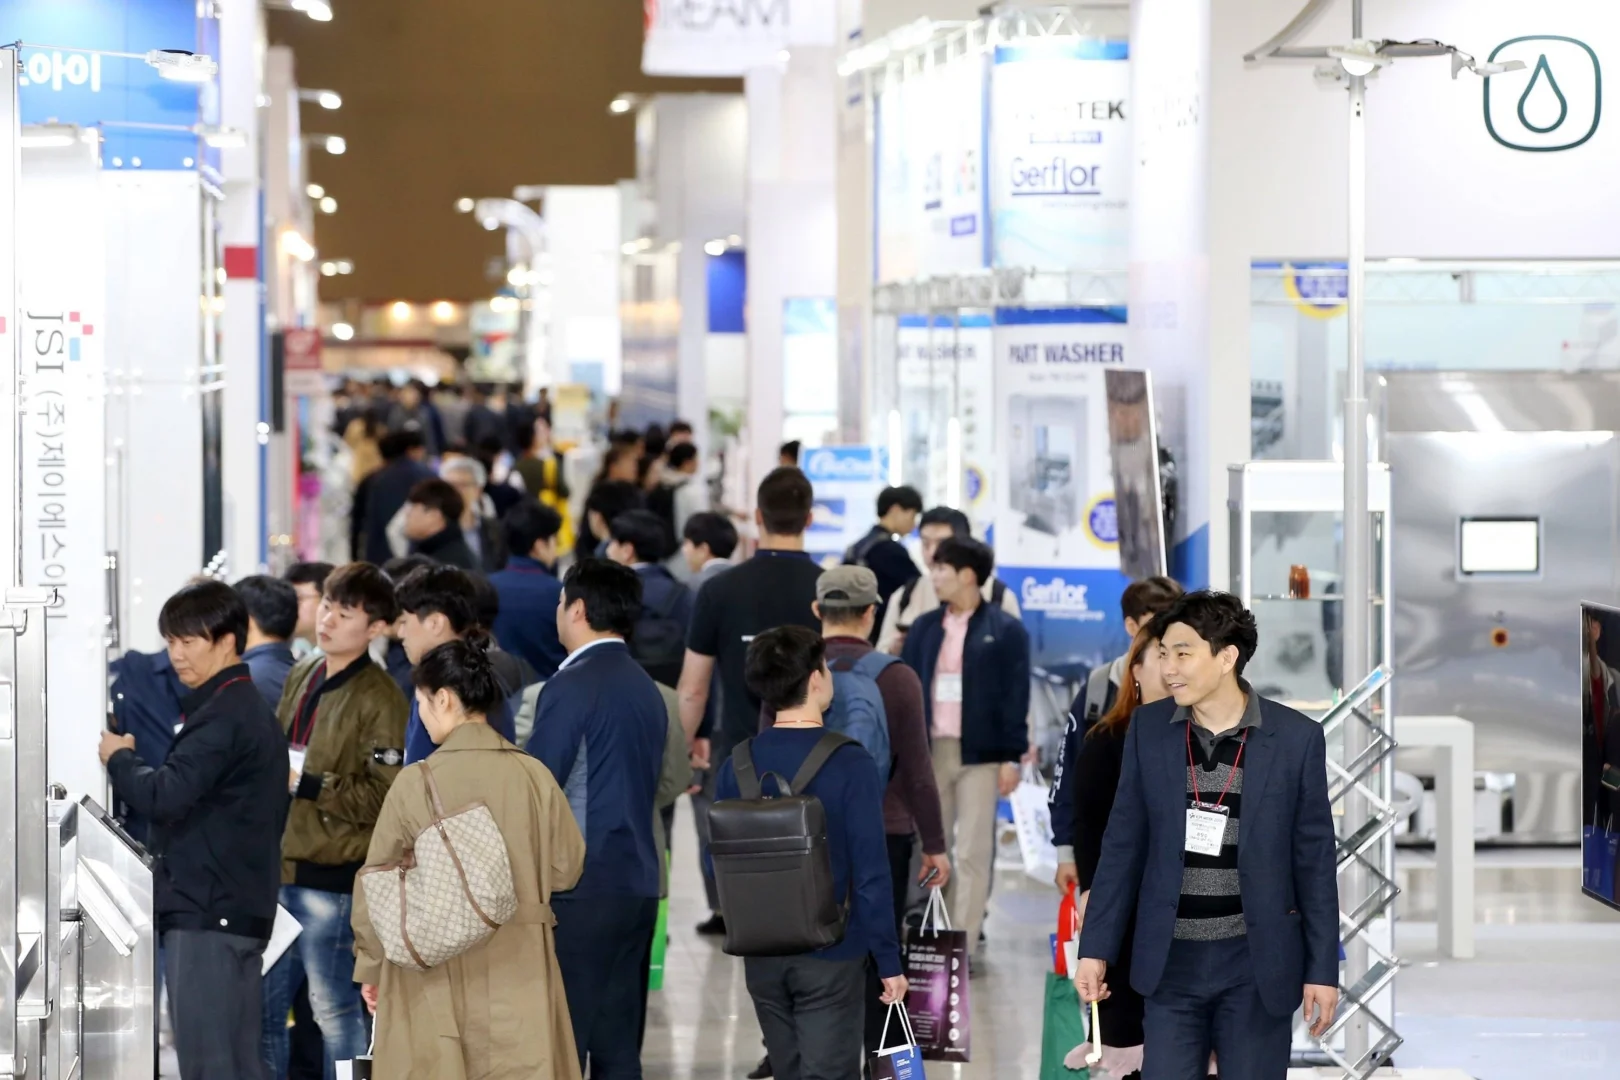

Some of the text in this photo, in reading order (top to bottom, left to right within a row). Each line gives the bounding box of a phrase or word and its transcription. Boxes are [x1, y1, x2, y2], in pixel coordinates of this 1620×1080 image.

[19, 51, 101, 92] 아이
[1011, 157, 1101, 194] Gerflor
[27, 311, 64, 373] JSI
[1044, 342, 1123, 363] WASHER
